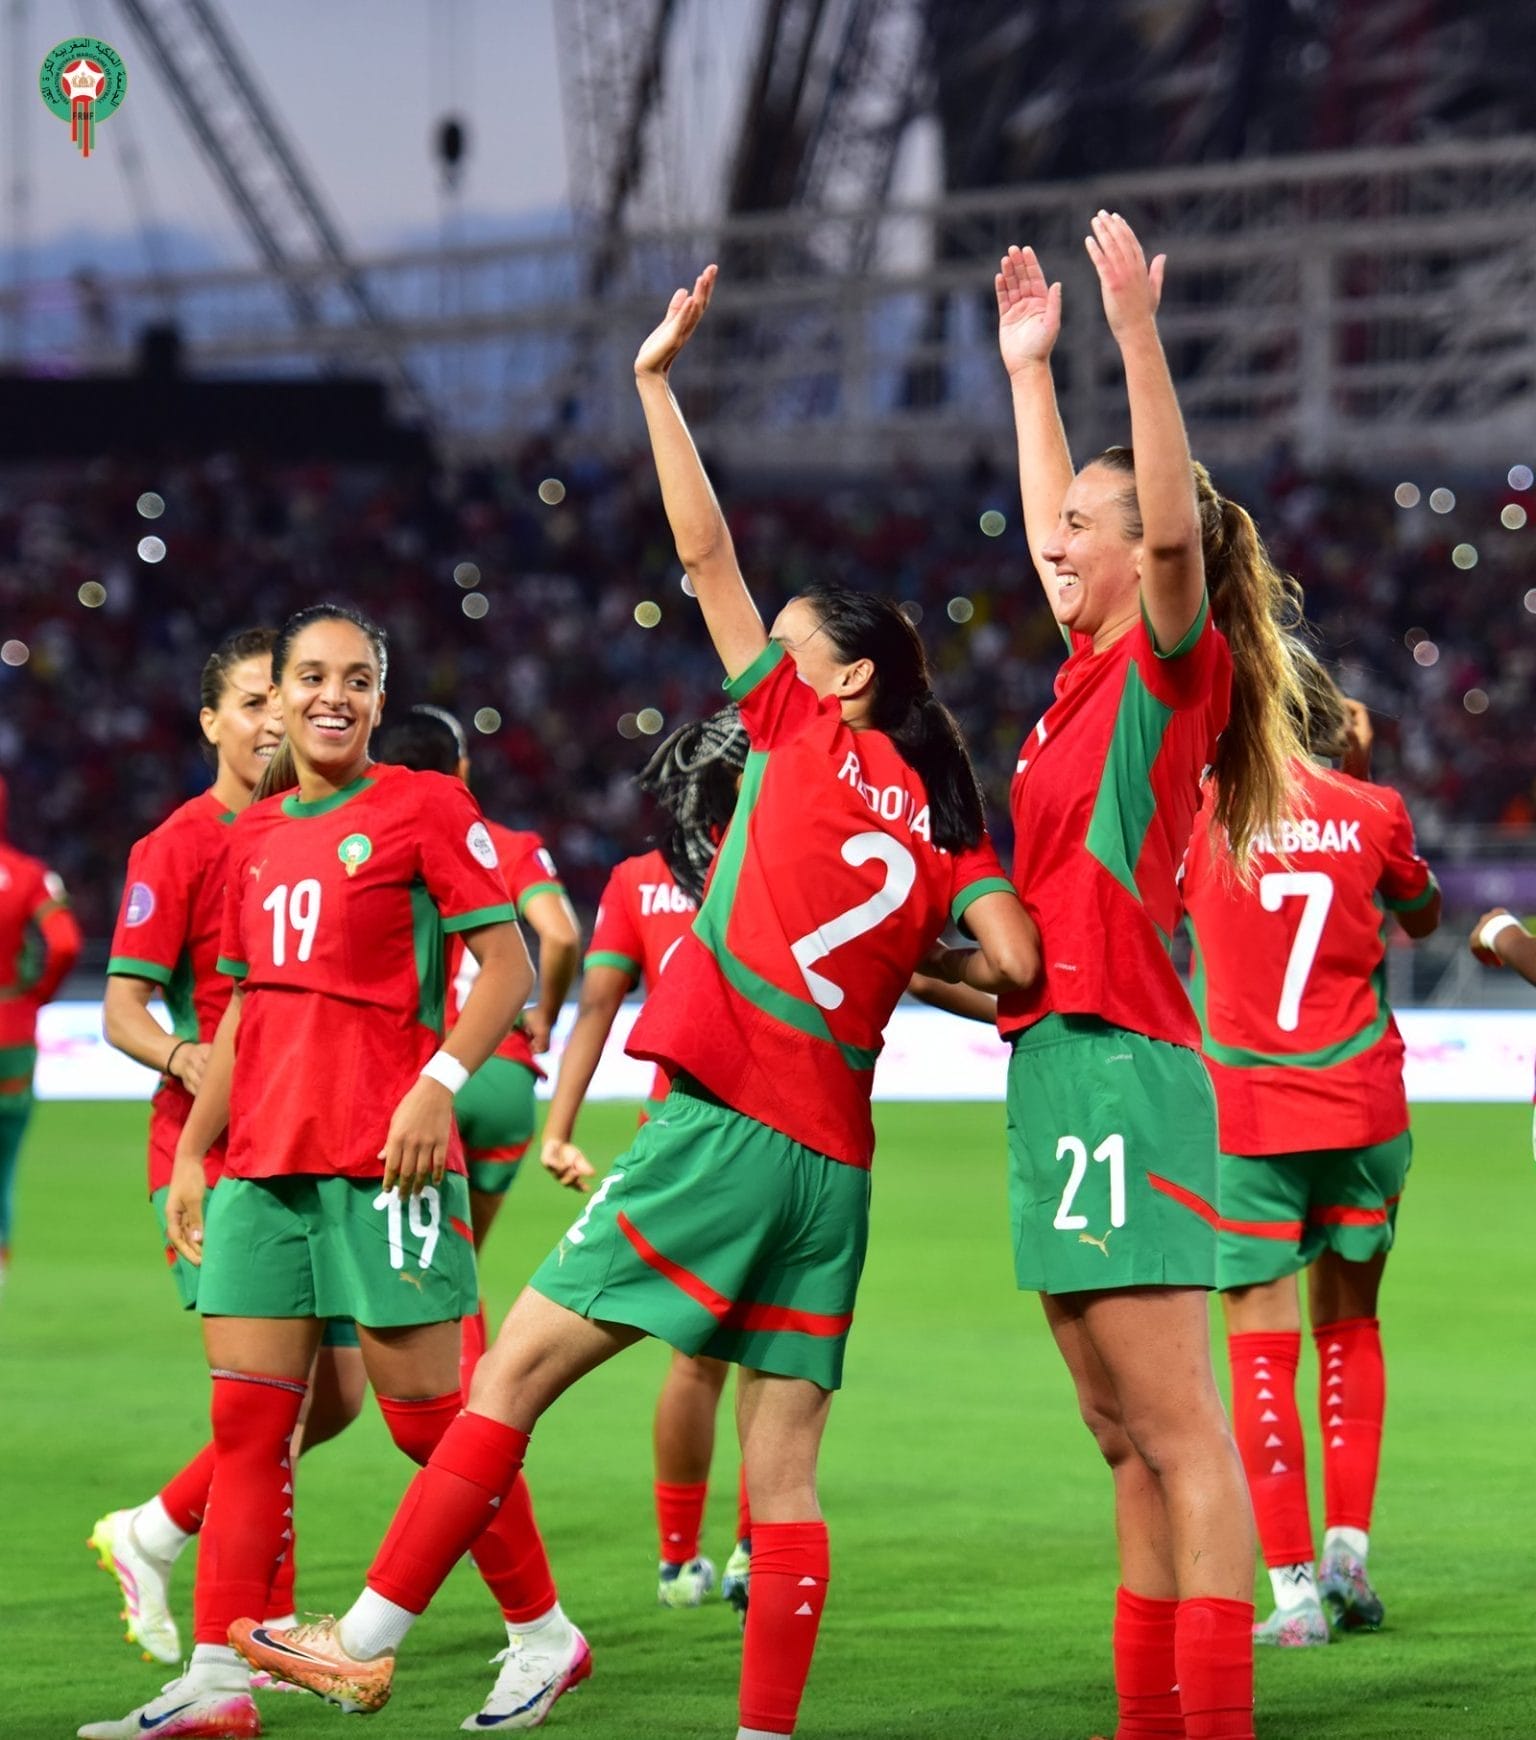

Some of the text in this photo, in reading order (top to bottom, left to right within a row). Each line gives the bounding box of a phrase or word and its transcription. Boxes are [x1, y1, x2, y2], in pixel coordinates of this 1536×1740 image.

[262, 878, 322, 967] 19
[790, 830, 917, 1011] 2
[1259, 871, 1334, 1032] 7
[372, 1185, 441, 1270] 19
[1053, 1133, 1126, 1230] 21
